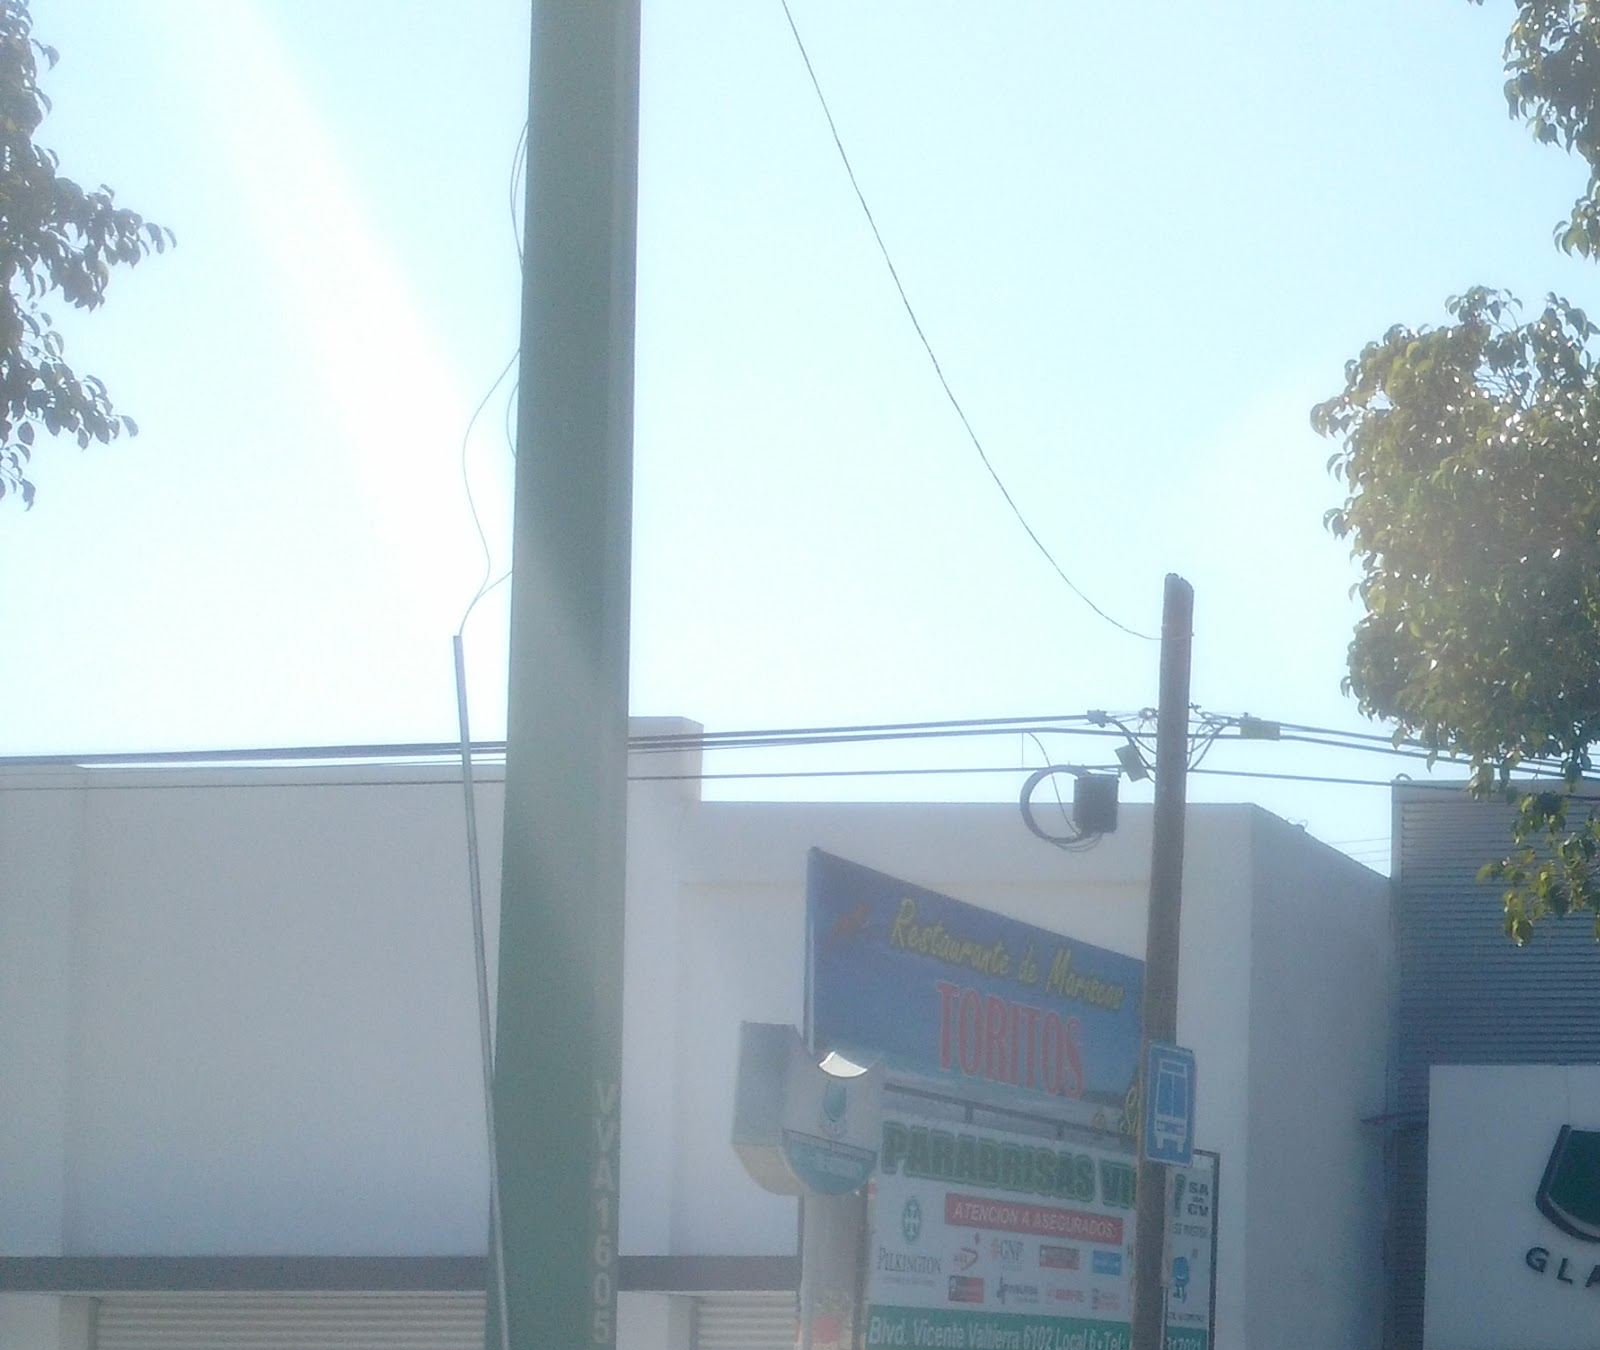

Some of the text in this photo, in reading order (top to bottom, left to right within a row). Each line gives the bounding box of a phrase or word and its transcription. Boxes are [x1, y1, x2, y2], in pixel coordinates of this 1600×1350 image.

[889, 897, 1125, 1011] Restaurante de Mariscos
[935, 980, 1083, 1101] TORITOS
[881, 1120, 1096, 1204] PARABRISAS
[1188, 1181, 1209, 1197] SA
[955, 1202, 1018, 1231] ATENCION
[1021, 1210, 1032, 1227] A
[1187, 1203, 1209, 1217] CV
[876, 1245, 943, 1275] PILKINGTON
[868, 1316, 906, 1346] Blvd.
[913, 1317, 964, 1348] Vicente
[968, 1321, 1020, 1350] Valtierra
